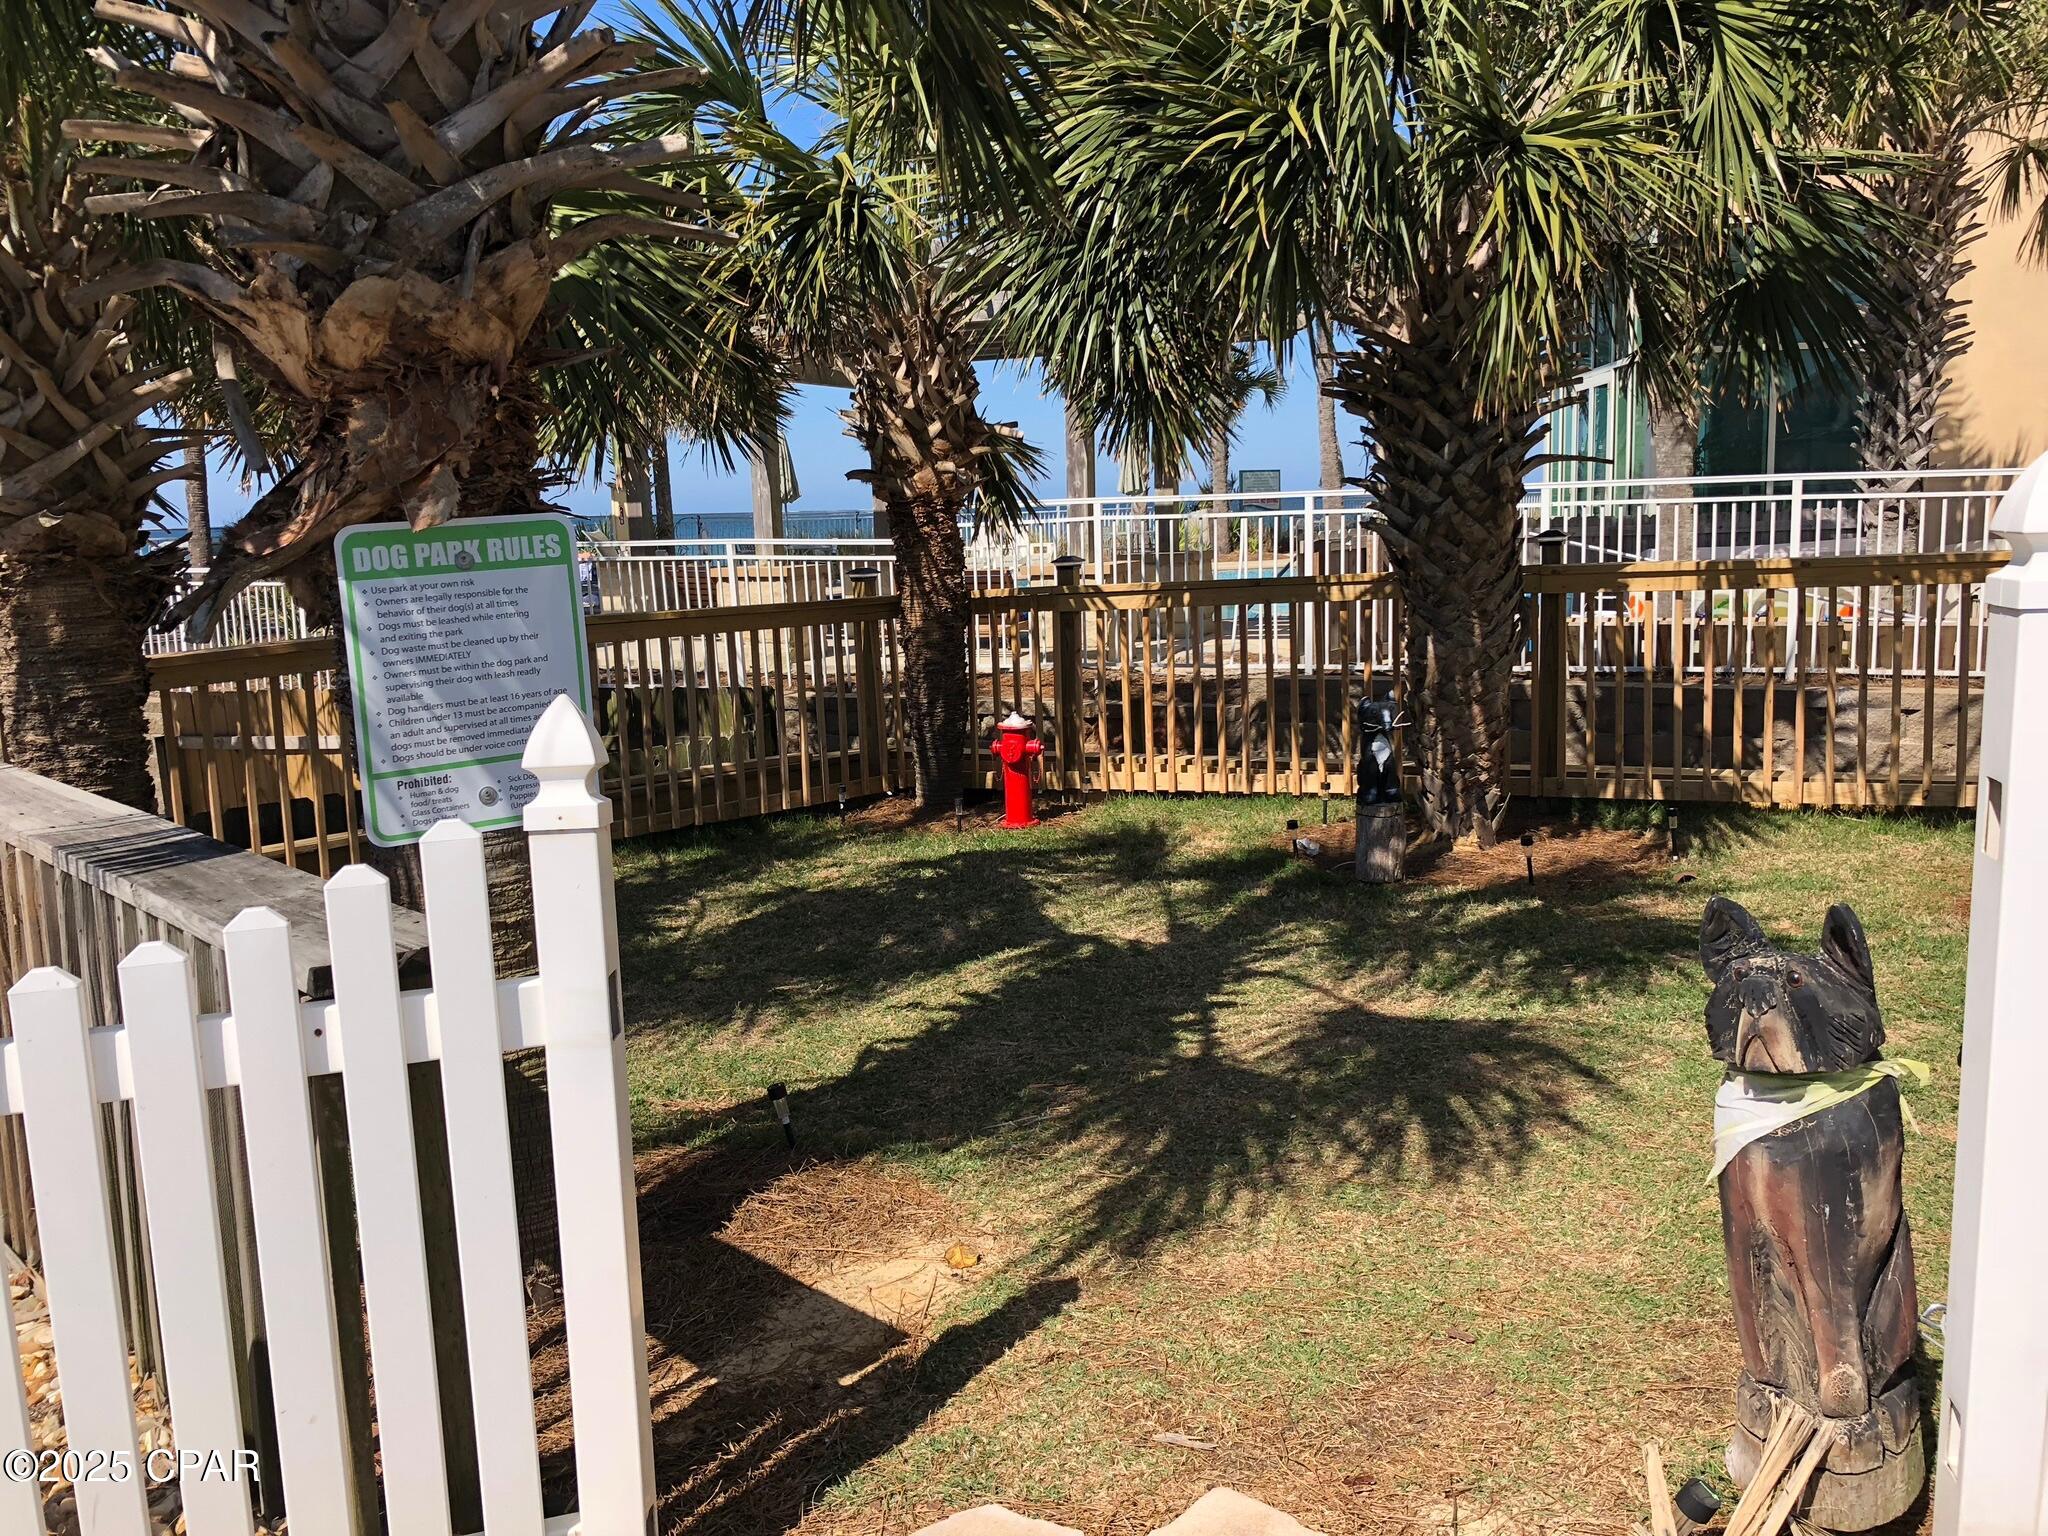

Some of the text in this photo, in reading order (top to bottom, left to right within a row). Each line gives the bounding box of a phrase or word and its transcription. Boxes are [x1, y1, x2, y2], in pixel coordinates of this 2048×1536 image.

[352, 534, 561, 572] DOG PARK RULES
[371, 586, 387, 594] Use
[389, 584, 408, 594] park
[420, 582, 438, 592] your
[440, 580, 459, 589] own
[460, 578, 475, 587] risk
[375, 586, 528, 607] Owners are legally responsible for the
[377, 600, 519, 619] behavior of their dog(s) at all times
[378, 610, 529, 632] Dogs must be leashed while entering
[380, 628, 464, 643] and exiting the park
[381, 632, 539, 656] Dog waste must be cleaned up by their
[382, 651, 472, 668] owners IMMEDIATELY
[384, 654, 549, 680] Owners must be within the dog park and
[385, 680, 434, 692] supervising
[435, 678, 454, 686] their
[456, 675, 473, 684] dog
[475, 672, 493, 681] with
[494, 669, 515, 679] leash
[386, 692, 424, 704] available
[388, 707, 406, 716] Dog
[407, 702, 444, 713] handlers
[445, 699, 466, 708] must
[468, 698, 479, 706] be
[480, 696, 489, 704] at
[489, 694, 509, 703] least
[510, 692, 520, 700] 16
[521, 690, 542, 700] years
[553, 687, 568, 695] age
[388, 718, 425, 728] Children
[426, 714, 451, 723] under
[453, 711, 463, 719] 13
[464, 709, 485, 717] must
[487, 706, 497, 715] be
[390, 732, 401, 740] an
[402, 728, 425, 737] adult
[426, 726, 442, 735] and
[443, 720, 488, 733] supervised
[499, 717, 508, 725] all
[510, 715, 532, 723] times
[391, 743, 412, 752] dogs
[413, 740, 435, 748] must
[437, 737, 448, 745] be
[449, 731, 485, 743] removed
[392, 738, 528, 763] Dogs should be under voice contr
[397, 774, 452, 790] Prohibited:
[509, 782, 540, 792] Aggressi
[410, 790, 437, 799] Human
[445, 786, 459, 794] dog
[410, 796, 453, 808] food/ treats
[412, 803, 470, 817] Glass Containers
[413, 818, 432, 827] Dogs
